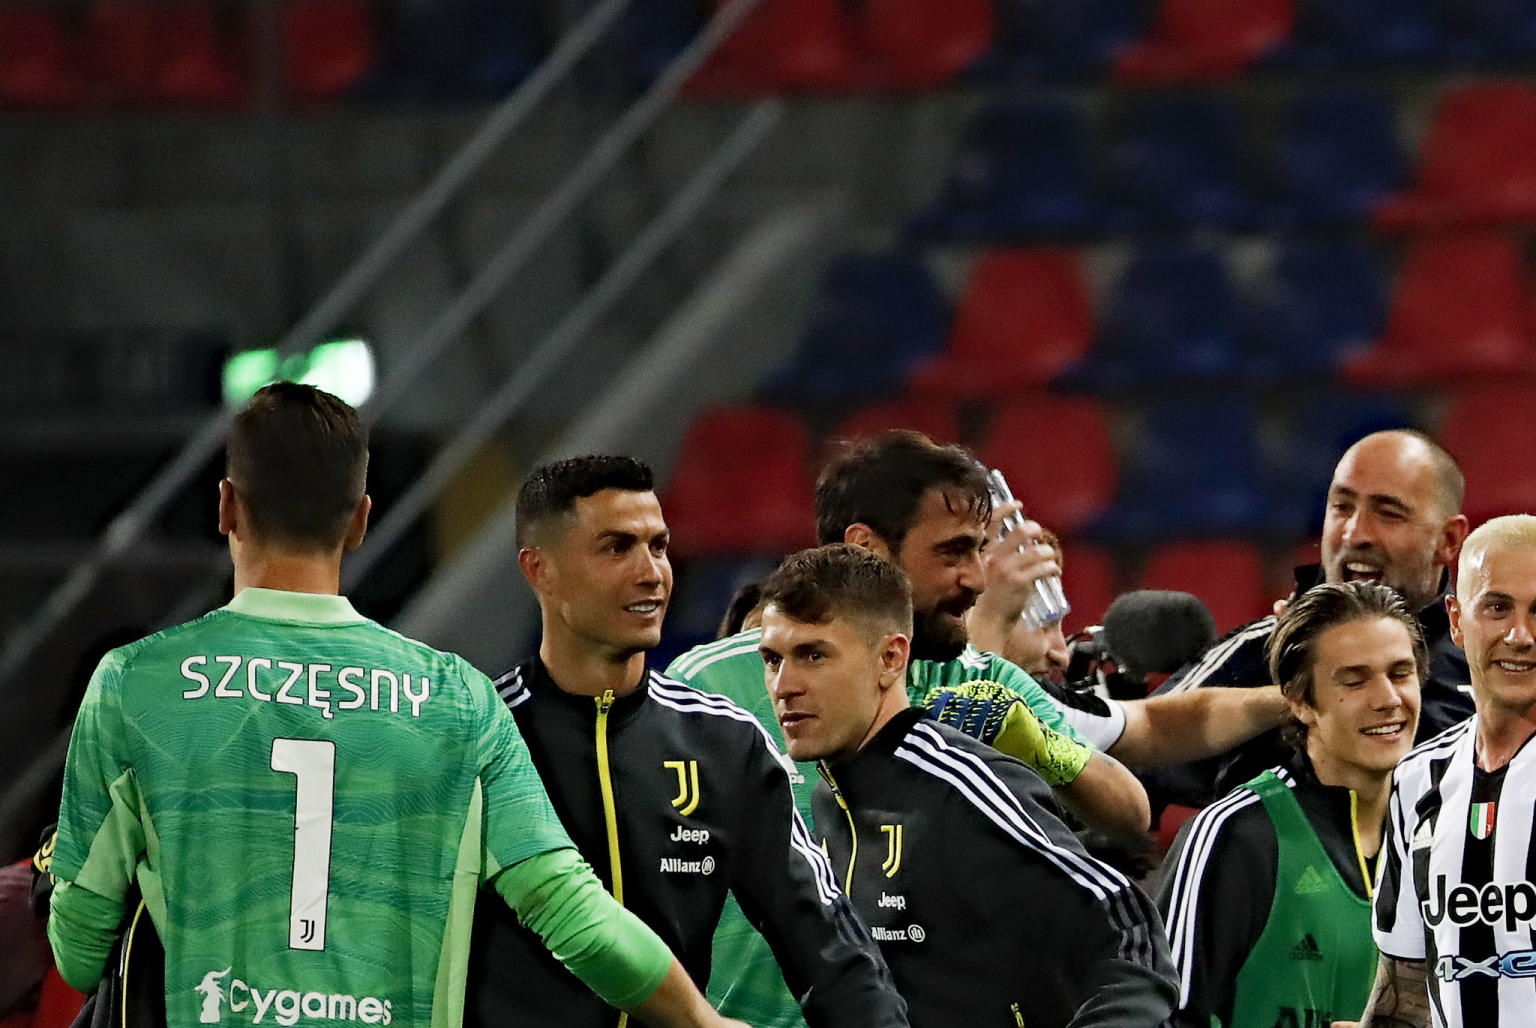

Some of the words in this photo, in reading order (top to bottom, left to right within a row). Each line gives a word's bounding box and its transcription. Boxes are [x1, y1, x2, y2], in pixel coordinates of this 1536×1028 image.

[180, 655, 430, 718] SZCZĘSNY
[269, 737, 336, 951] 1
[670, 825, 709, 845] Jeep
[660, 857, 700, 874] Allianz
[878, 891, 906, 910] Jeep
[229, 979, 392, 1026] Cygames
